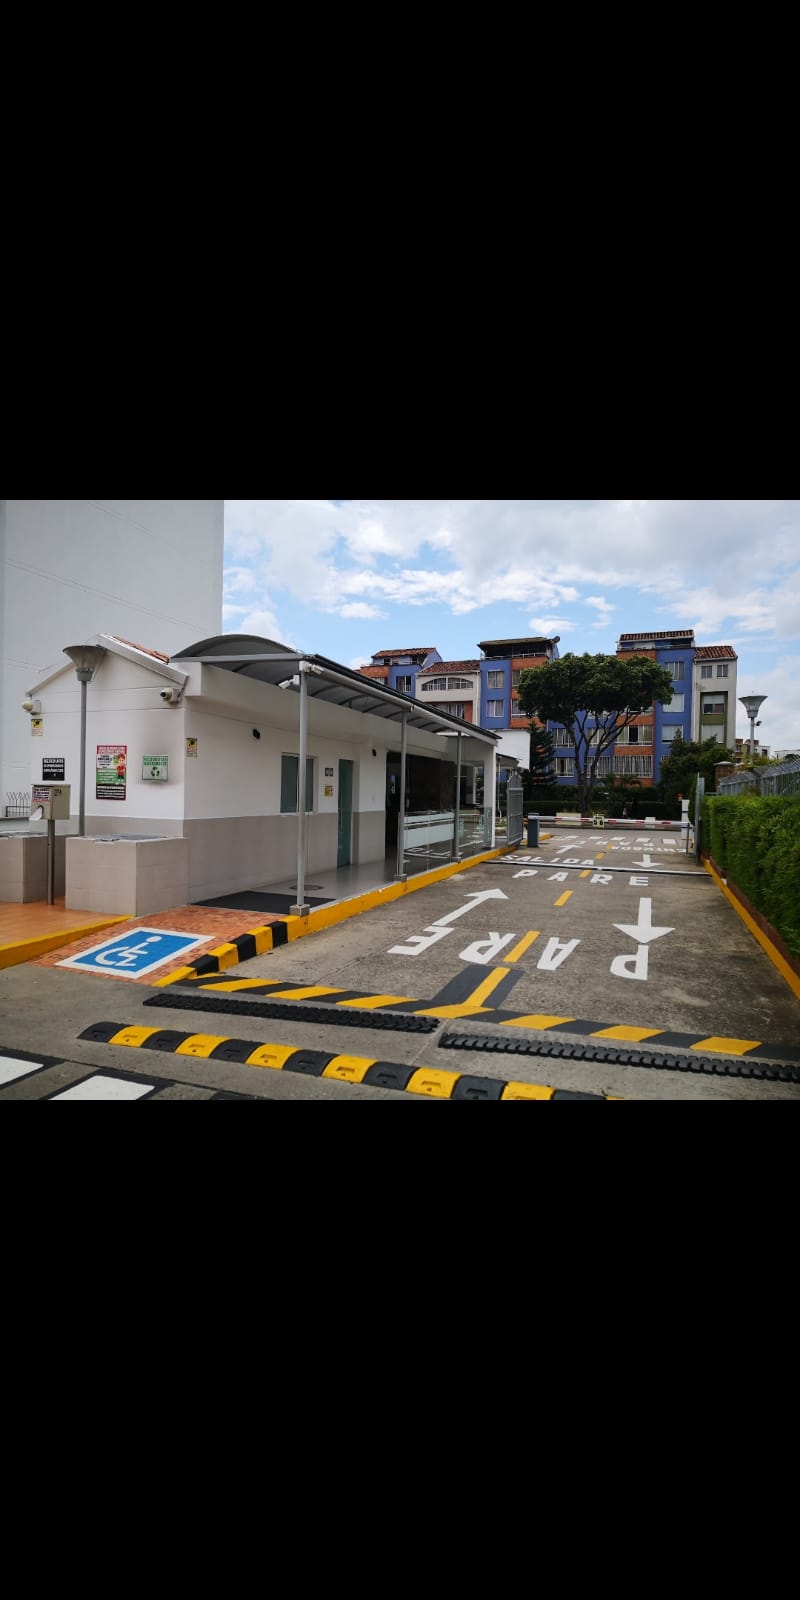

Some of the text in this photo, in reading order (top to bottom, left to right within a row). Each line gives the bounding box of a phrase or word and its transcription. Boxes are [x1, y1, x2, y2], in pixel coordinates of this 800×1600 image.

[501, 854, 594, 865] SALIDA
[512, 869, 649, 887] PARE
[386, 925, 649, 980] PARE
